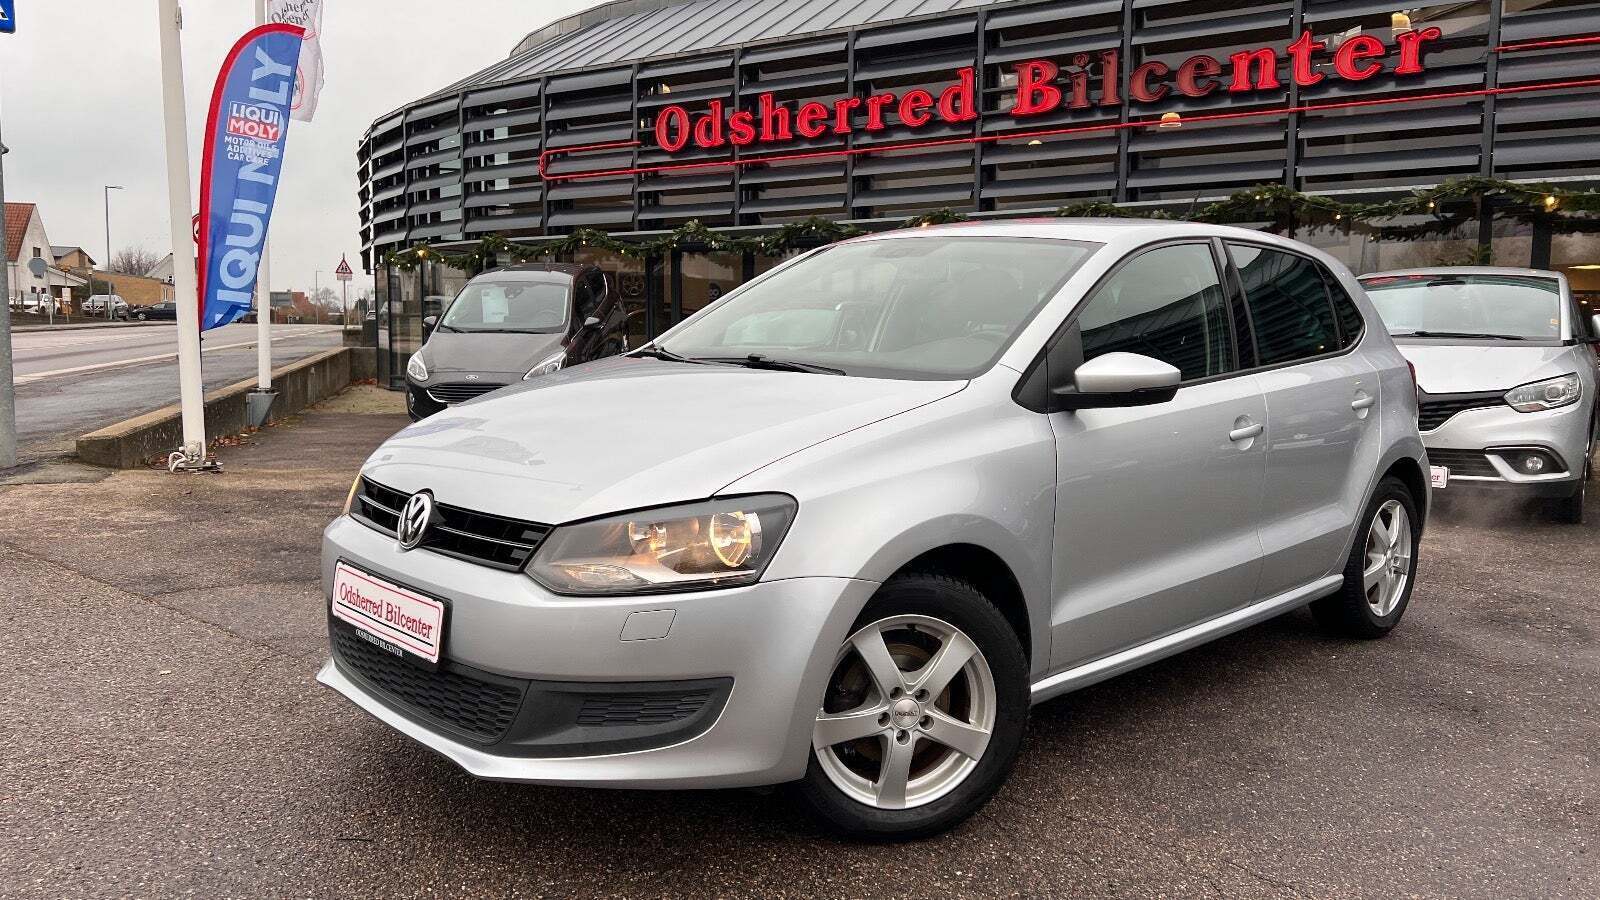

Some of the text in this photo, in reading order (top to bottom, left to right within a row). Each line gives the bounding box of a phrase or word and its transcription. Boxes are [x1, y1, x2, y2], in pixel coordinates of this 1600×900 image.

[655, 26, 1442, 152] Odsherred Bilcenter
[231, 103, 279, 125] LIQUI
[229, 118, 278, 139] MOLY
[224, 135, 256, 146] MOTOR
[227, 151, 245, 161] CAR
[339, 582, 433, 640] Odsherred Bilcenter
